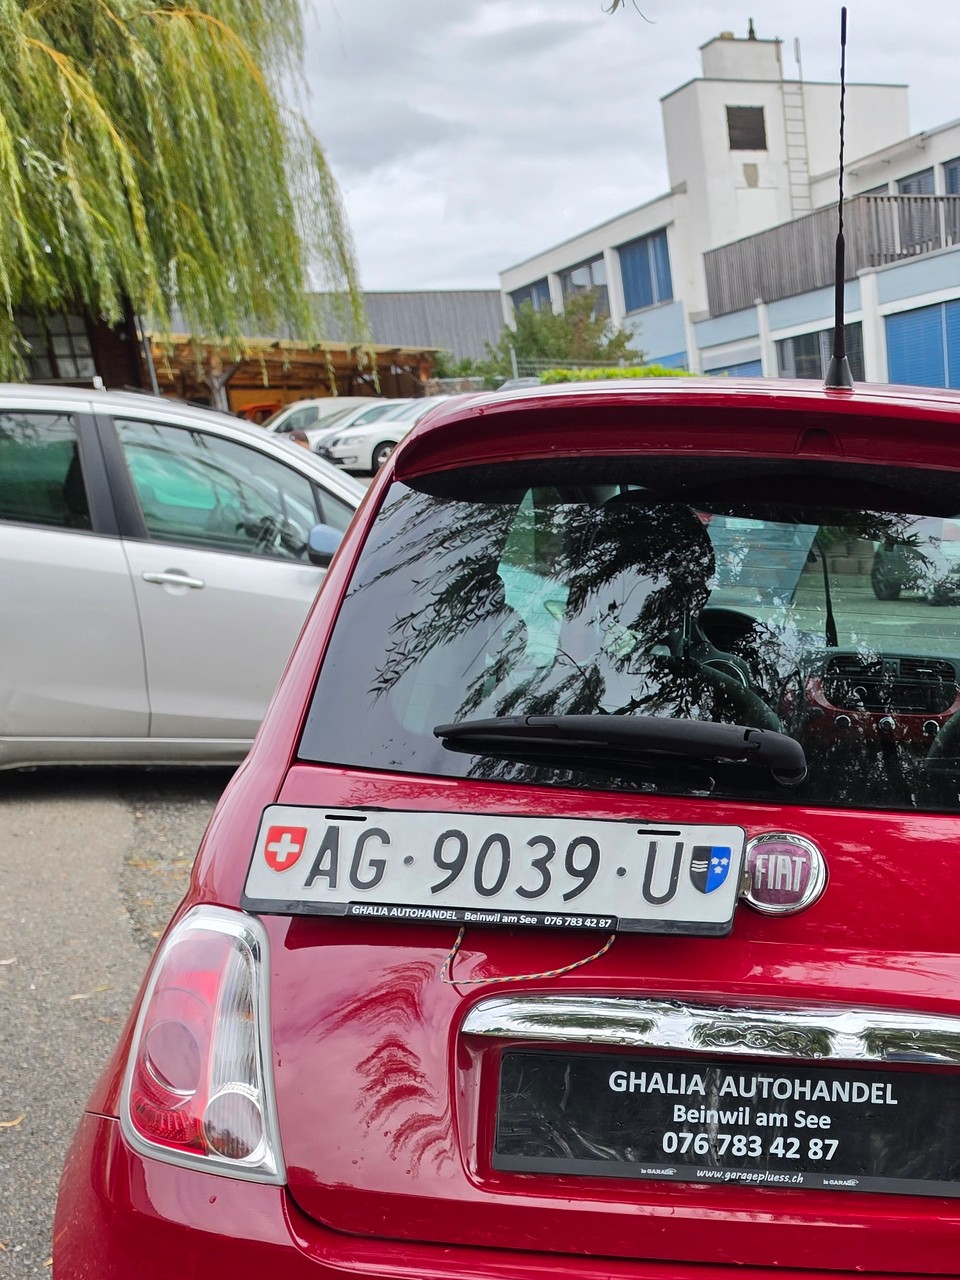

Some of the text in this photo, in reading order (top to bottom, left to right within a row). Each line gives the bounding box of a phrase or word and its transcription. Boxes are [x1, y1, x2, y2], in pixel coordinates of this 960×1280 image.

[754, 854, 807, 892] FIAT
[351, 905, 612, 929] GHALIA AUTOHANDEL Beinwil am See 076 783 42 87
[608, 1070, 899, 1105] GHALIA AUTOHANDEL
[673, 1104, 832, 1130] Beinwil am See
[662, 1131, 840, 1161] 076 783 42 87
[696, 1169, 804, 1184] www.garagepluess.ch
